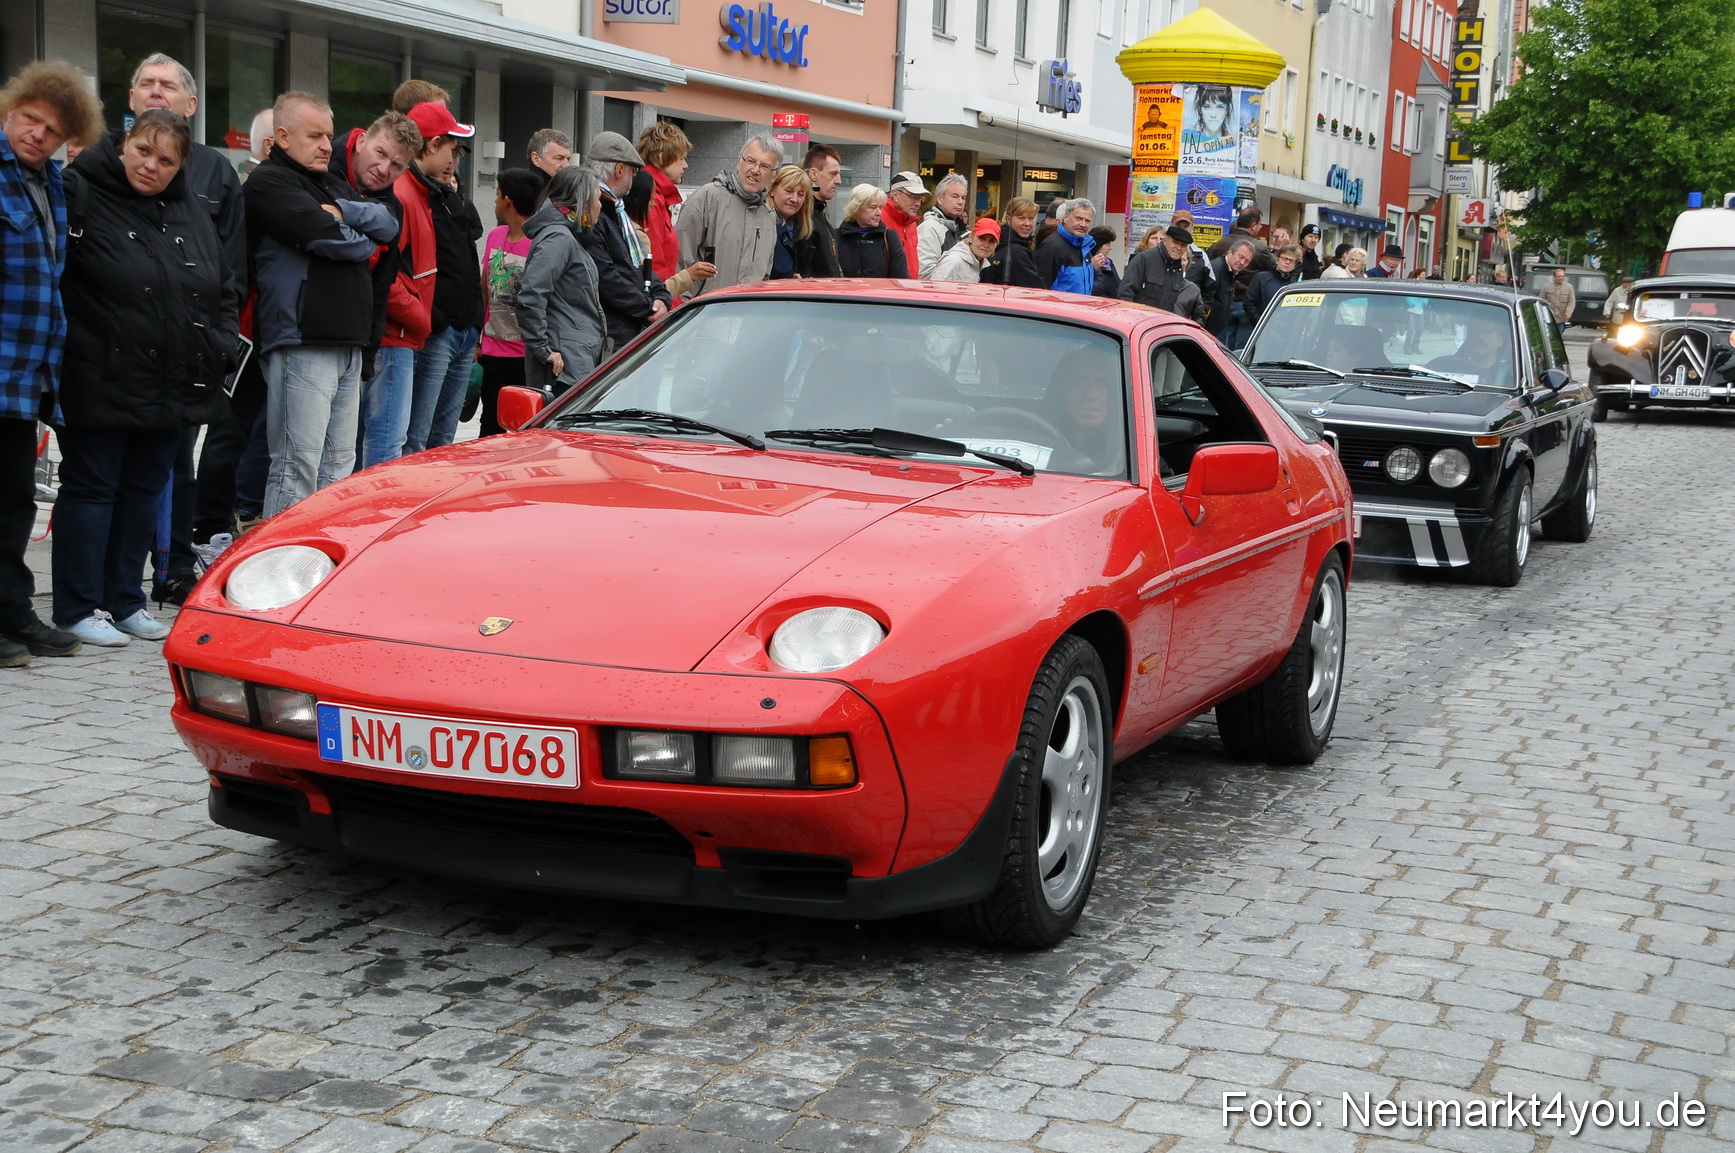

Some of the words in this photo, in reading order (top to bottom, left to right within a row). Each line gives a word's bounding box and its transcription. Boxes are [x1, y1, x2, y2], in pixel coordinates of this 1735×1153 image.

[727, 2, 809, 68] sutor.
[1048, 58, 1082, 113] fries
[1449, 20, 1483, 161] HOTEL
[1140, 143, 1170, 151] 01.06.
[1183, 131, 1202, 155] ZAZ
[1204, 141, 1224, 152] OPEN
[1225, 137, 1236, 149] AIR
[1182, 156, 1205, 165] 25.6.
[1024, 169, 1058, 180] FRIES
[1657, 387, 1669, 396] NM
[979, 446, 1021, 457] 403
[327, 738, 336, 751] D
[351, 715, 402, 764] NM
[429, 726, 566, 779] 07068
